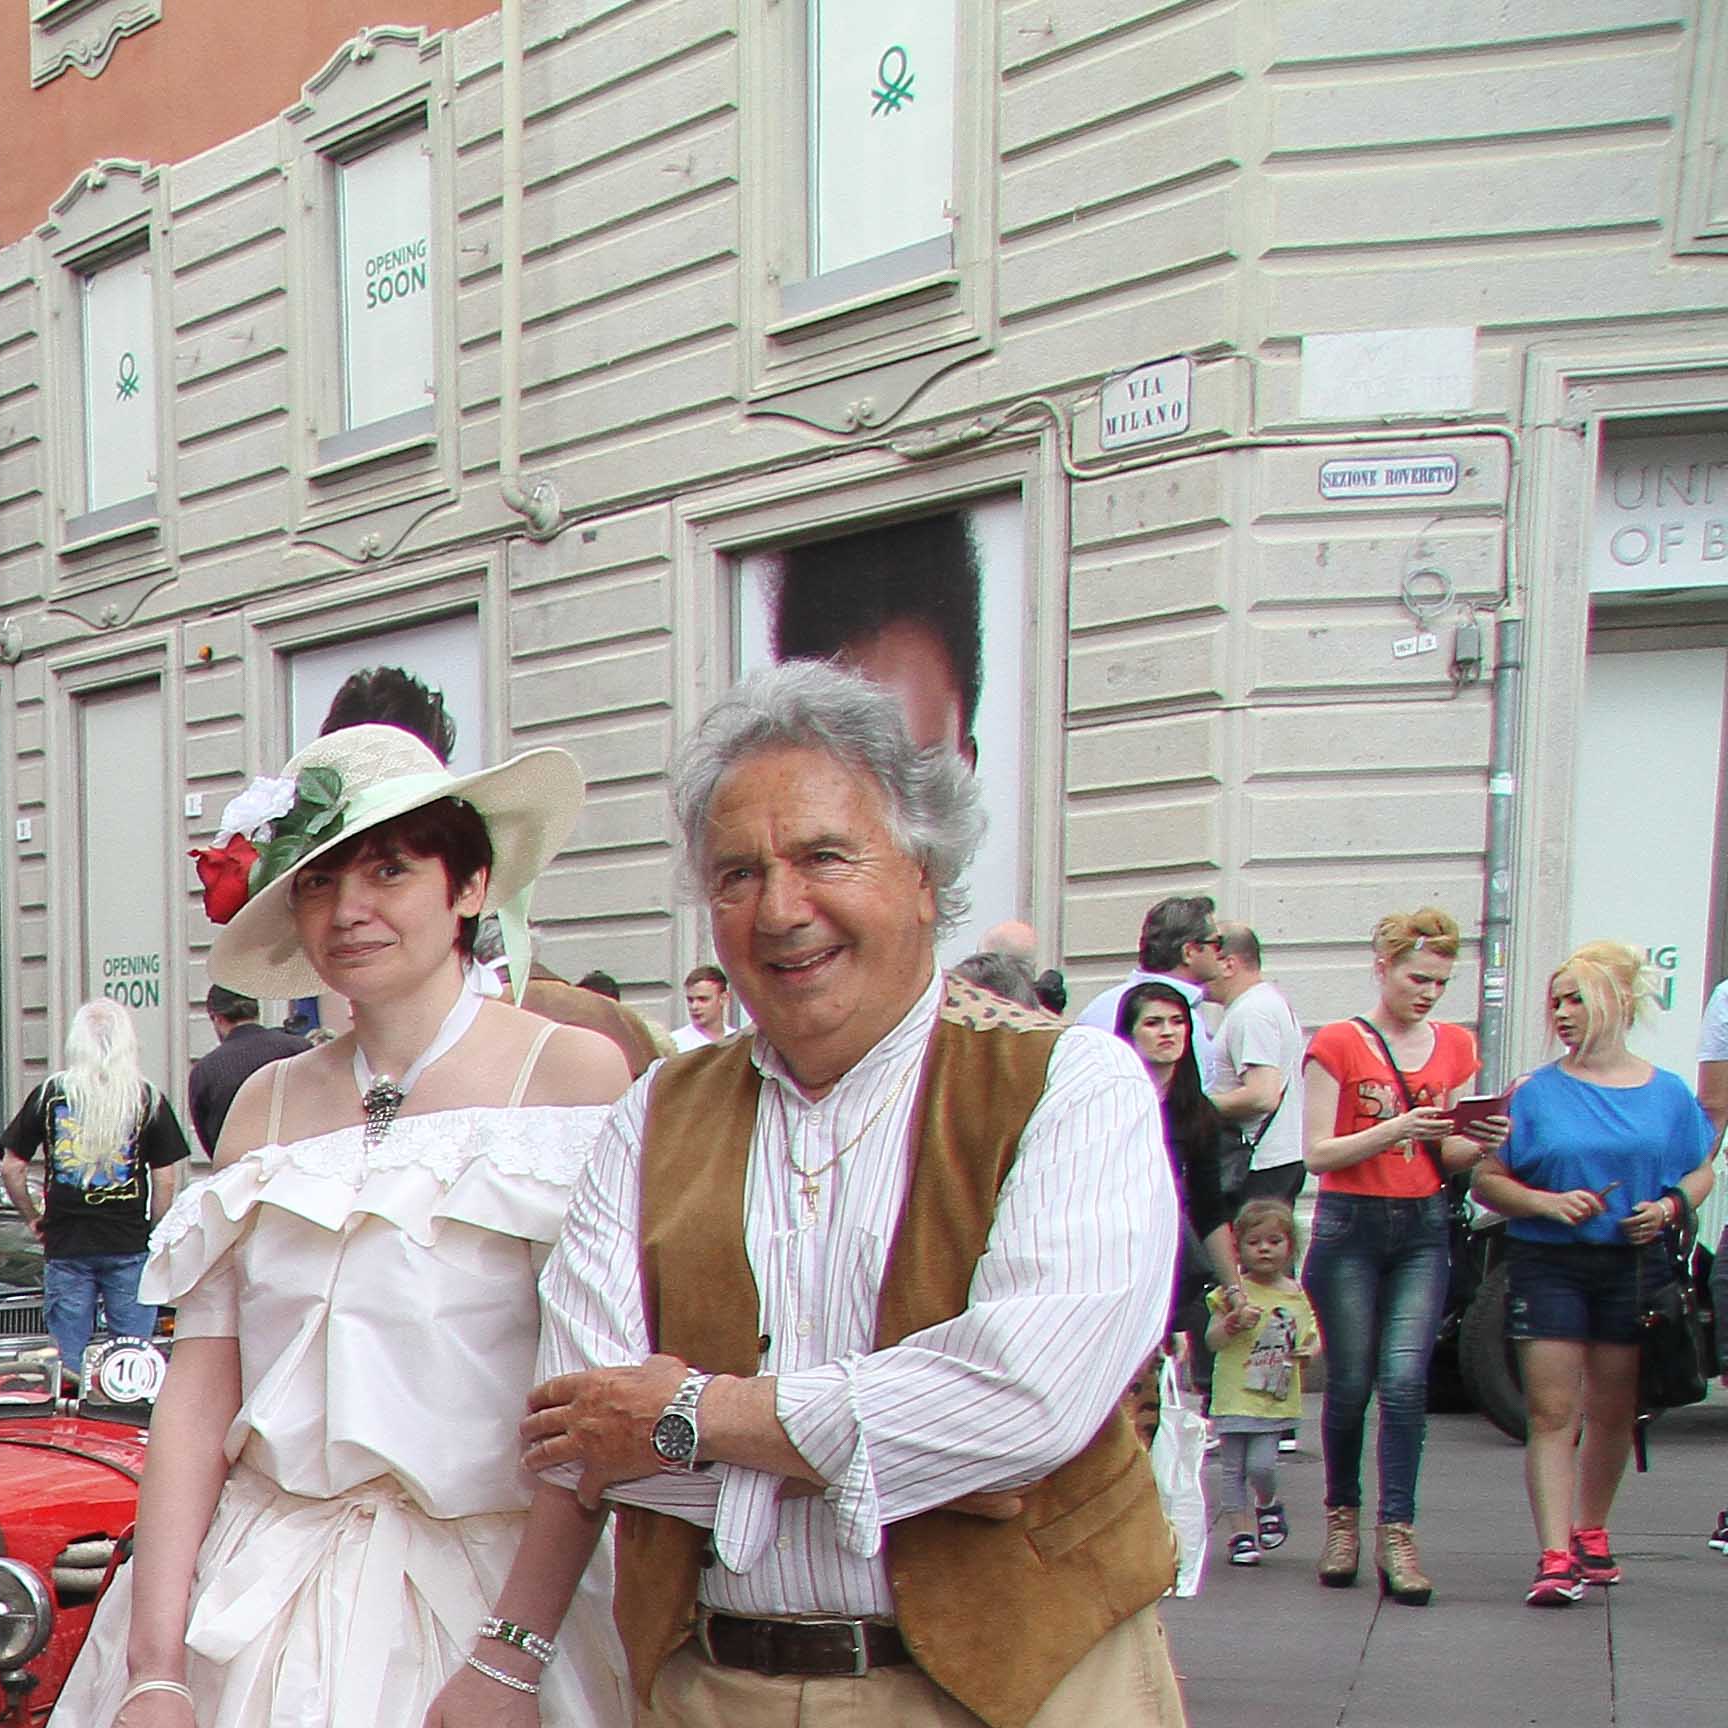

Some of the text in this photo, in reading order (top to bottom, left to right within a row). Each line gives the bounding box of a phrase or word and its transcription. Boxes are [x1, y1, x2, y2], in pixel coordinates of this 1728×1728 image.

[365, 238, 427, 278] OPENING
[366, 263, 426, 310] SOON
[1127, 377, 1162, 401] VIA
[1105, 402, 1182, 436] MILANO
[1322, 467, 1454, 489] SEZIONE ROVERETO
[1610, 523, 1685, 566] OF
[102, 953, 160, 977] OPENING
